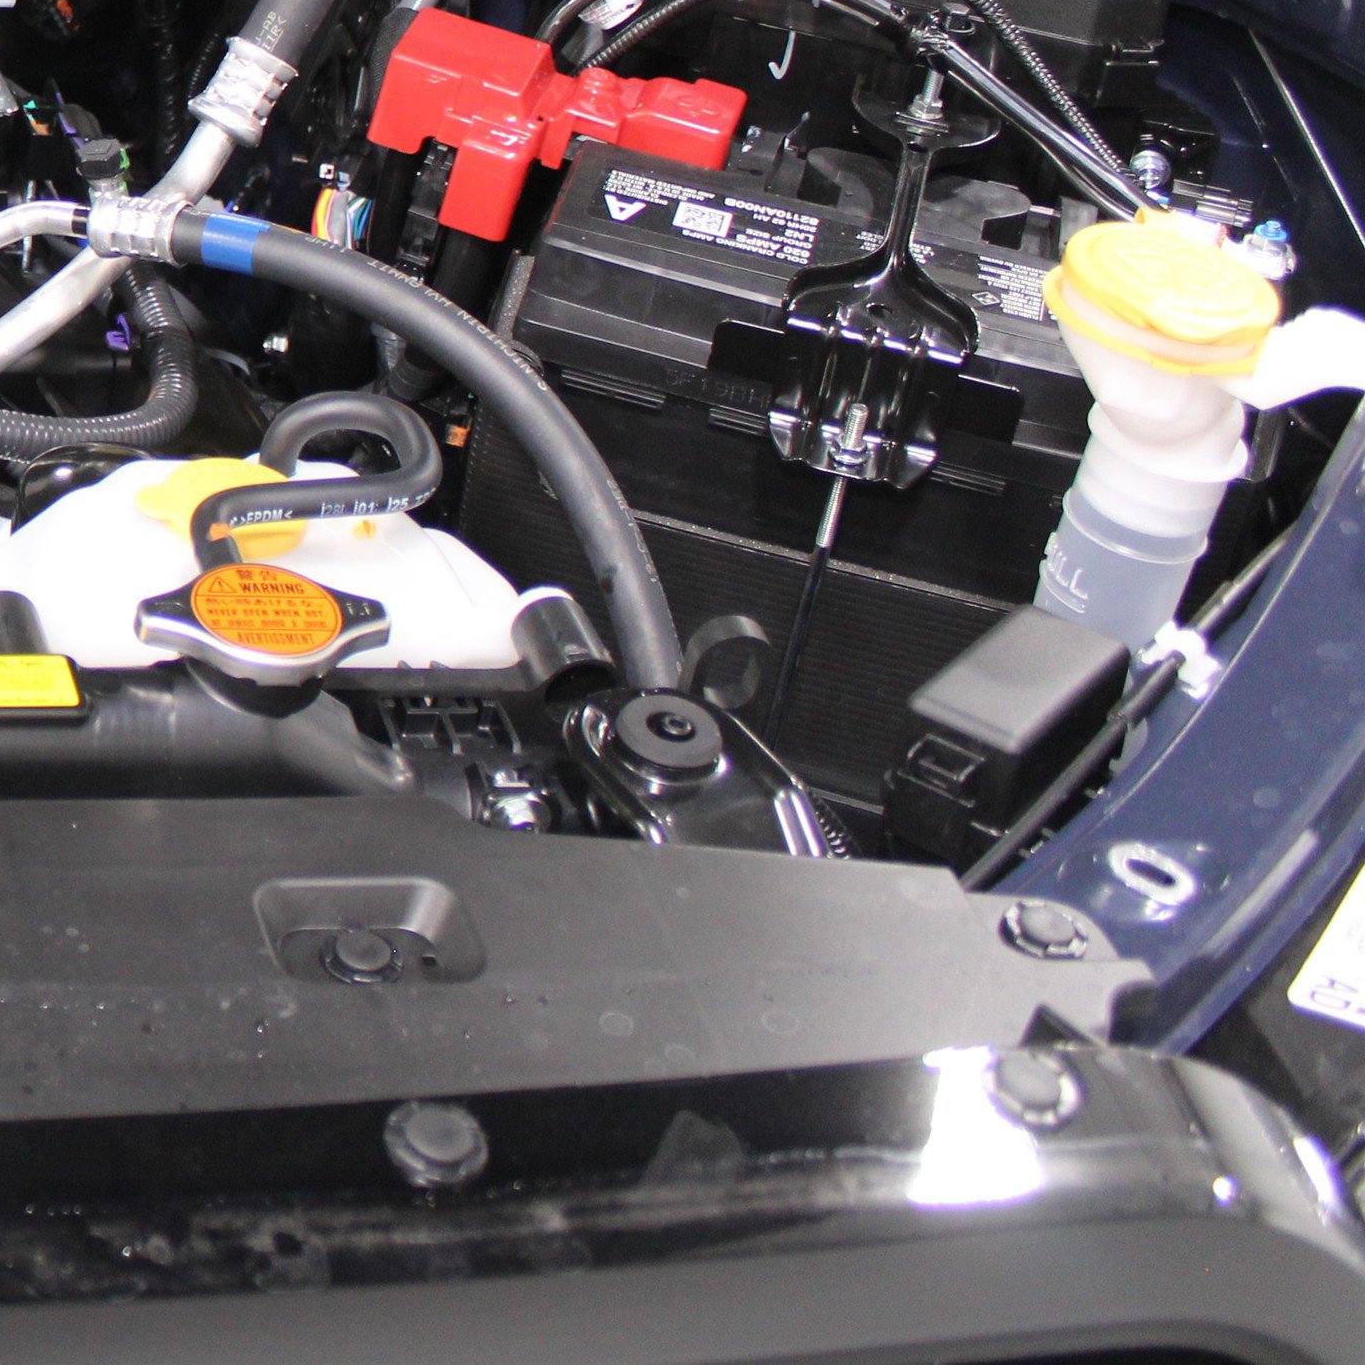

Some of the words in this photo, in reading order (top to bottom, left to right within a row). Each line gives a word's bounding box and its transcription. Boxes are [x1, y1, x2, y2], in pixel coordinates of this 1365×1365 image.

[724, 198, 819, 228] 82110AN00B
[680, 230, 713, 242] AMPS
[745, 228, 771, 239] SIZE
[784, 229, 815, 242] LN2
[715, 237, 775, 256] CRANKING
[736, 234, 781, 251] AMPS
[771, 235, 813, 249] GROUP
[776, 252, 808, 265] COLD
[783, 246, 810, 258] 620
[238, 583, 305, 595] WARNING
[207, 609, 237, 617] NEVER
[244, 609, 268, 617] OPEN
[274, 610, 300, 618] WHEN
